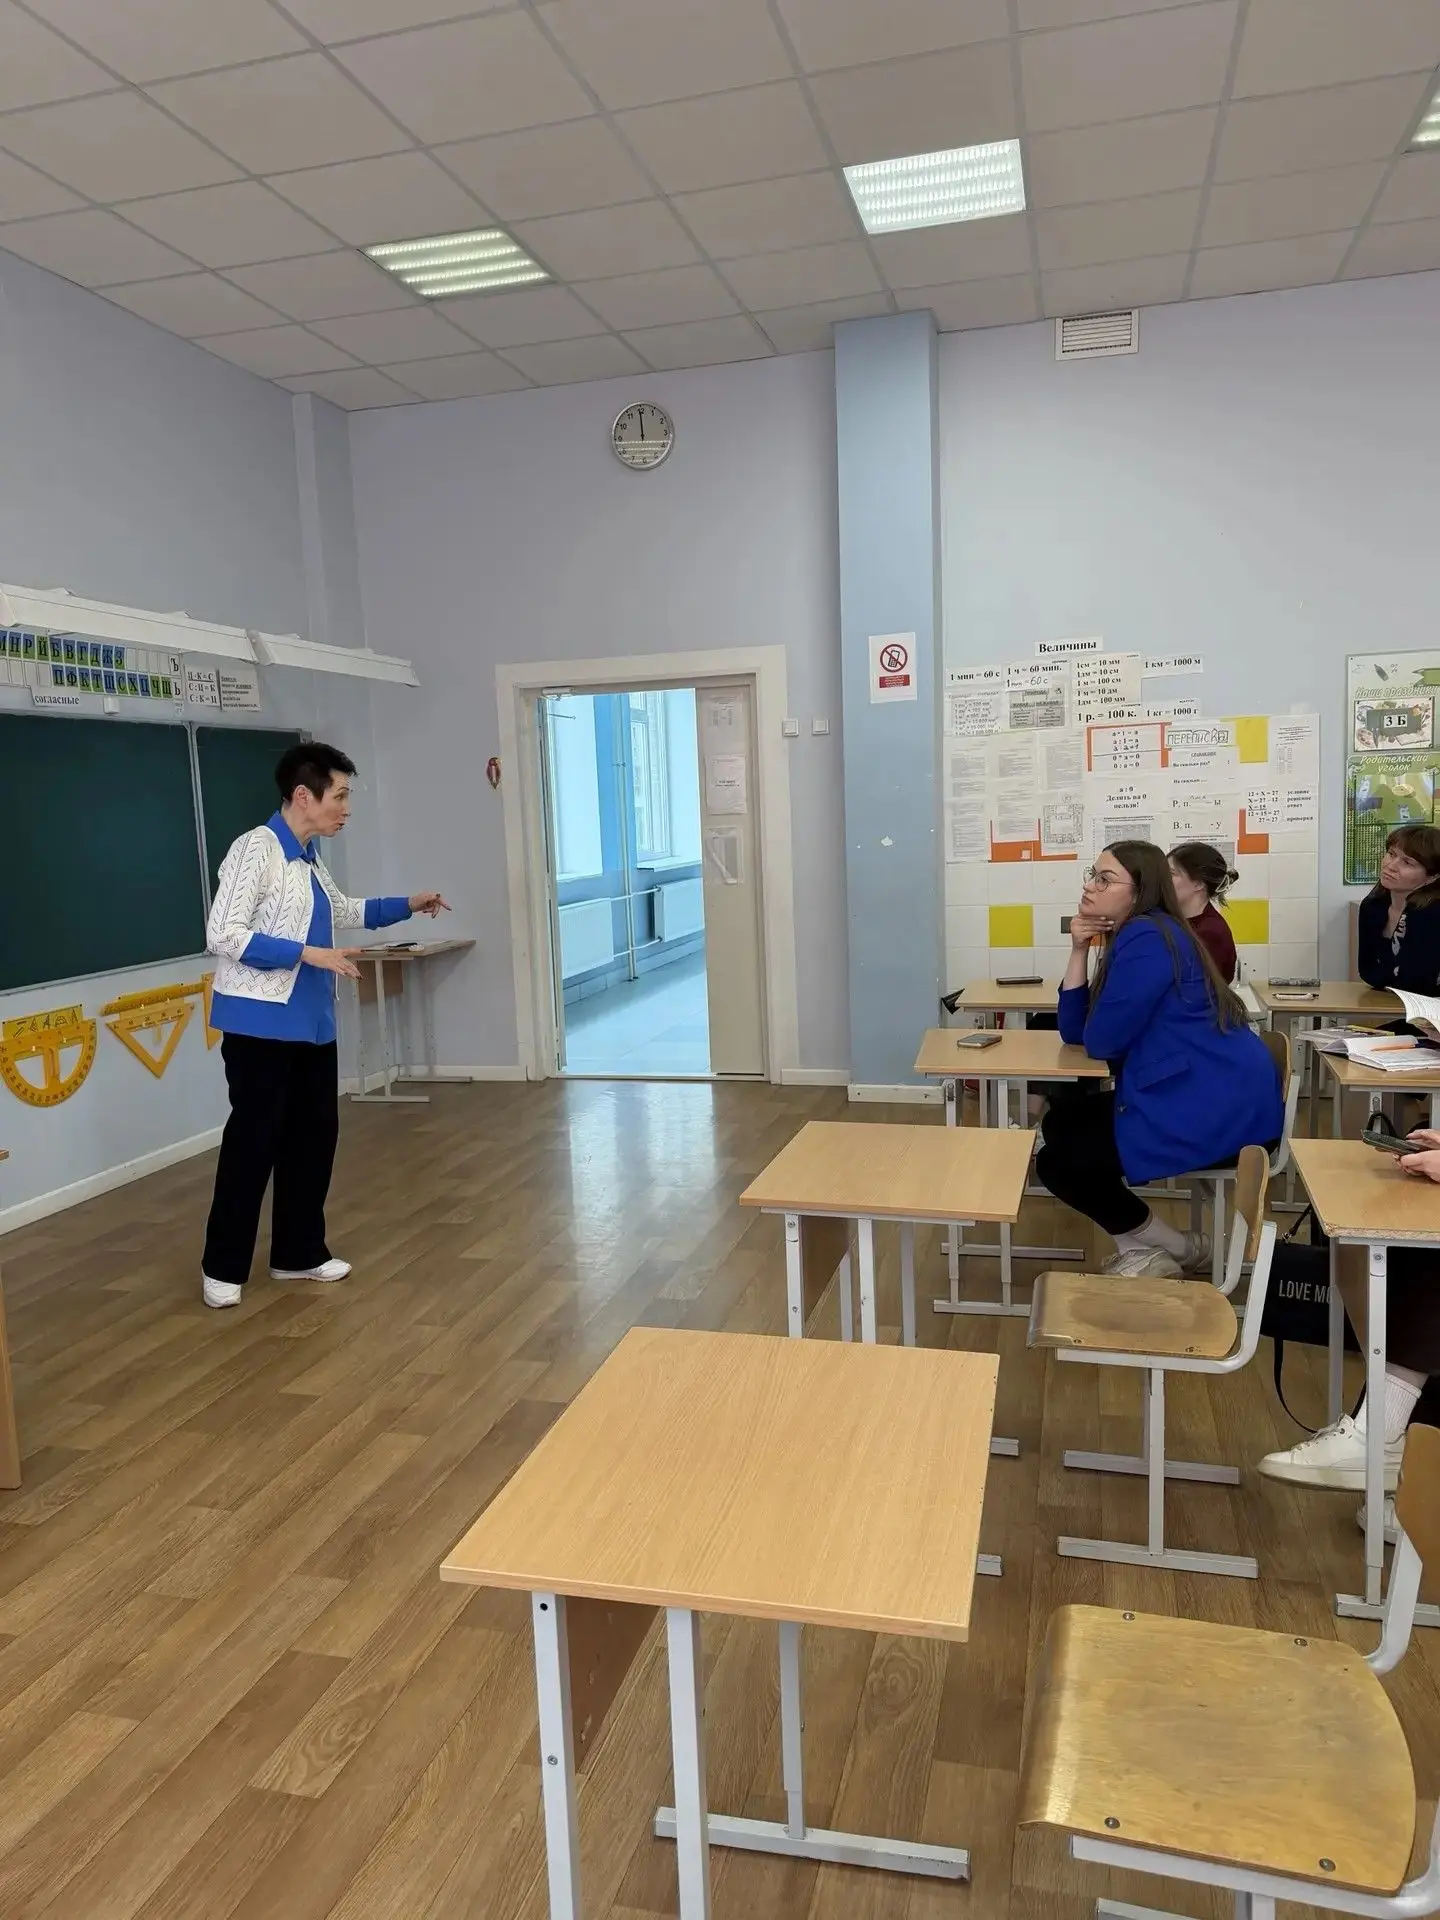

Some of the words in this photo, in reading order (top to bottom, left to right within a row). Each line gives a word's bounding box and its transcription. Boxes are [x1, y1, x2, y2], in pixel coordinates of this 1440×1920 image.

[10, 637, 20, 652] Н
[25, 638, 32, 654] Р
[52, 642, 60, 657] Б
[65, 644, 73, 659] В
[80, 646, 86, 661] Г
[90, 648, 99, 665] Д
[103, 649, 113, 664] Ж
[115, 650, 123, 665] З
[1039, 641, 1096, 653] Величины
[1174, 658, 1192, 666] 1000
[54, 670, 63, 685] П
[66, 671, 77, 686] Ф
[80, 672, 90, 687] К
[93, 673, 101, 688] Т
[104, 675, 116, 690] Ш
[118, 677, 126, 691] С
[129, 678, 138, 692] Х
[152, 680, 161, 693] Ч
[174, 683, 180, 695] Ь
[1030, 676, 1042, 685] 60
[1356, 687, 1381, 698] Наши
[35, 696, 79, 704] согласные
[1086, 713, 1095, 722] р.
[1107, 710, 1124, 719] 100
[1386, 716, 1392, 726] 3
[1398, 716, 1406, 726] Б
[1360, 755, 1428, 764] Родительский
[1378, 764, 1410, 773] уголок
[1279, 1280, 1311, 1301] LOVE
